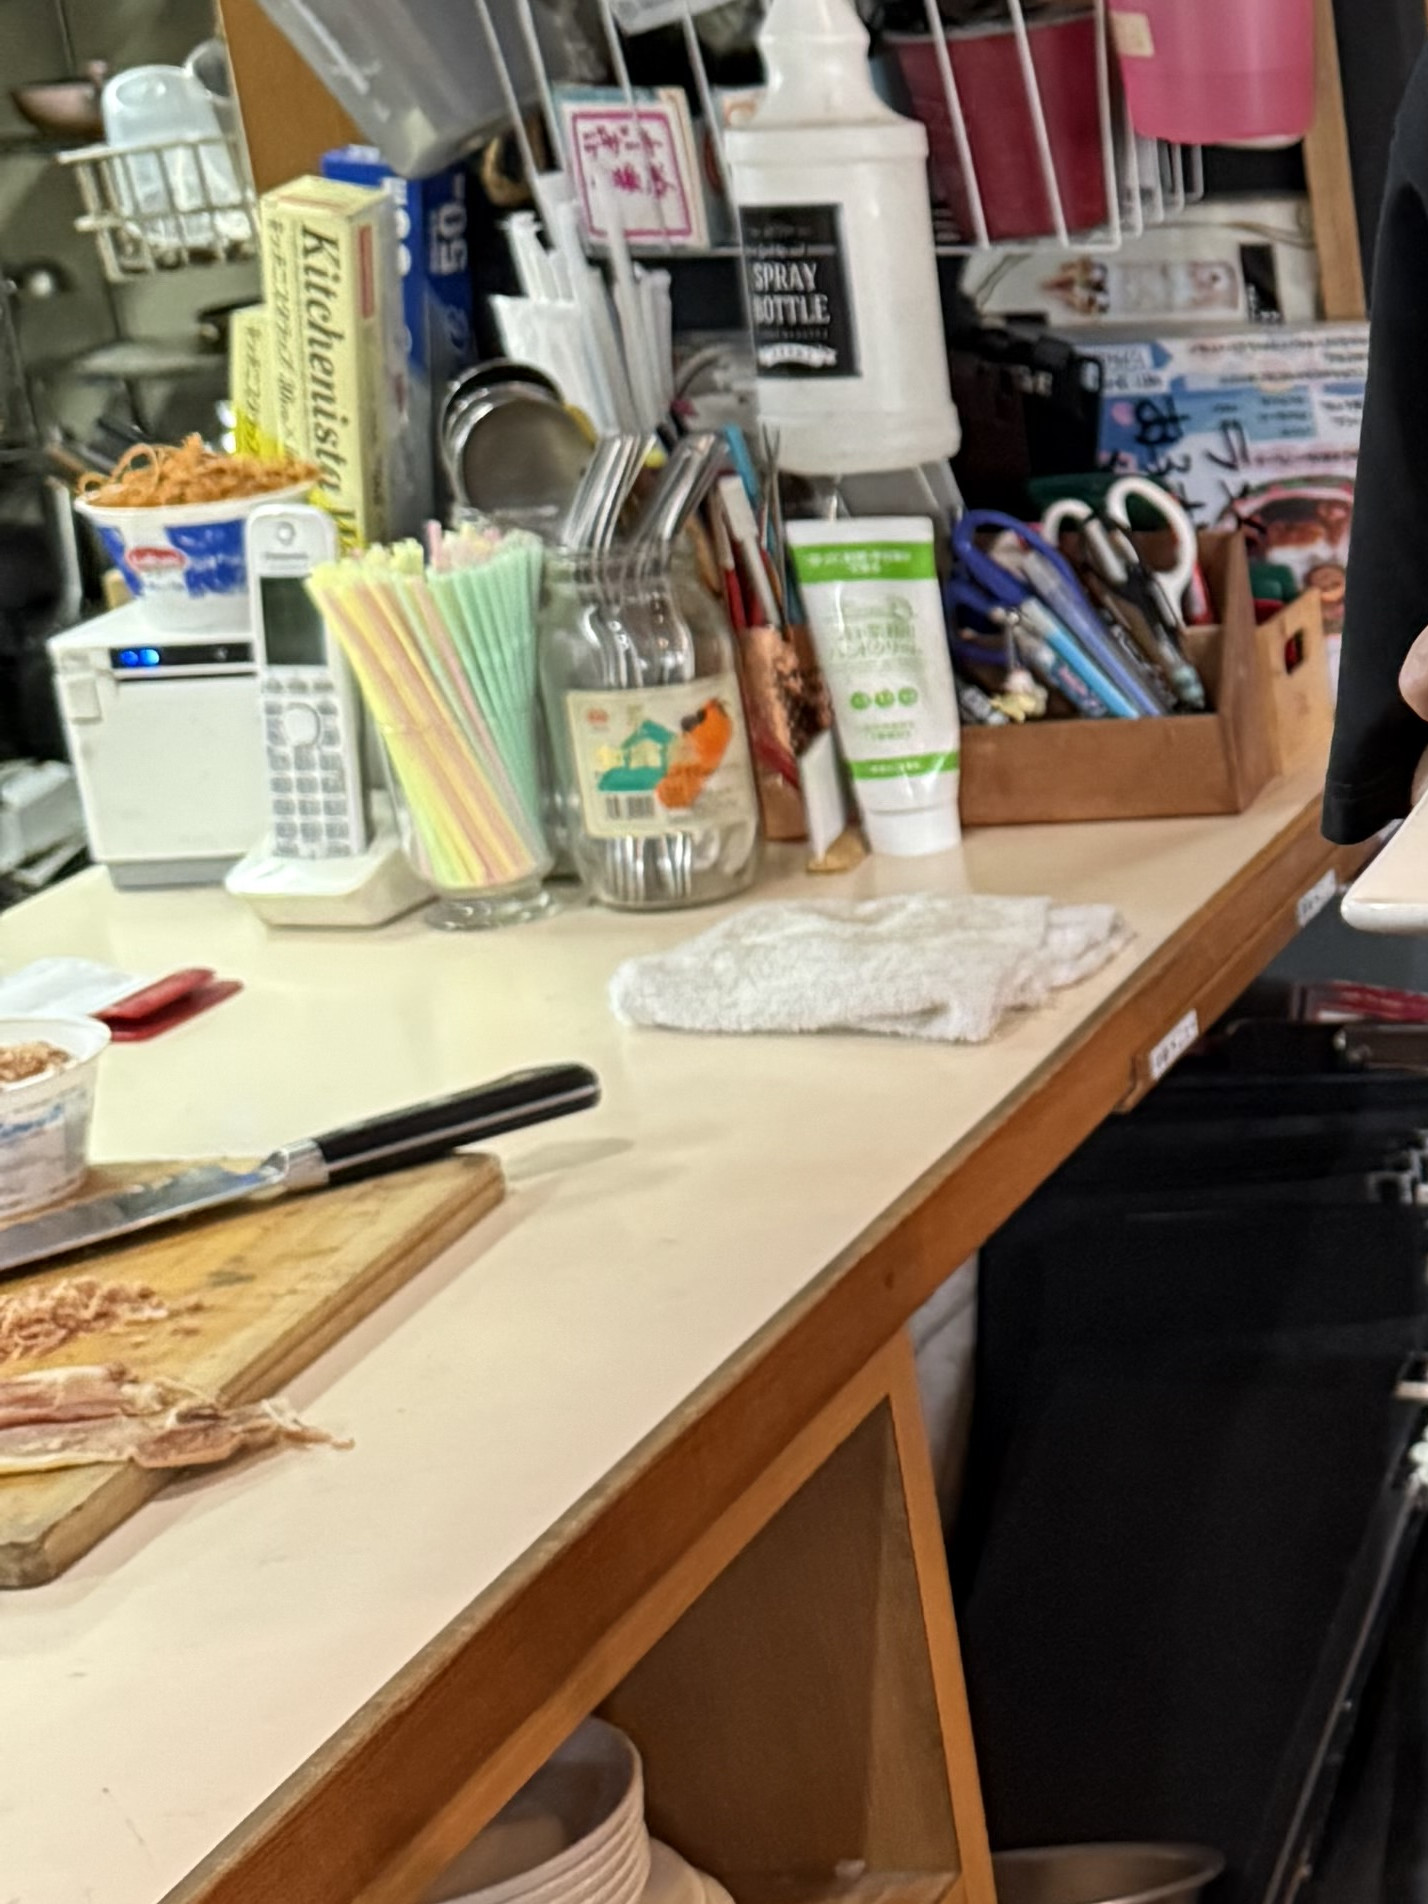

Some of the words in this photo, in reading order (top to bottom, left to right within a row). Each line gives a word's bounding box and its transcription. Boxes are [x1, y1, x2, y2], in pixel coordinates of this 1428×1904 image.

[752, 261, 817, 291] SPRAY
[752, 293, 831, 325] BOTTLE
[301, 223, 353, 494] Kitchenista
